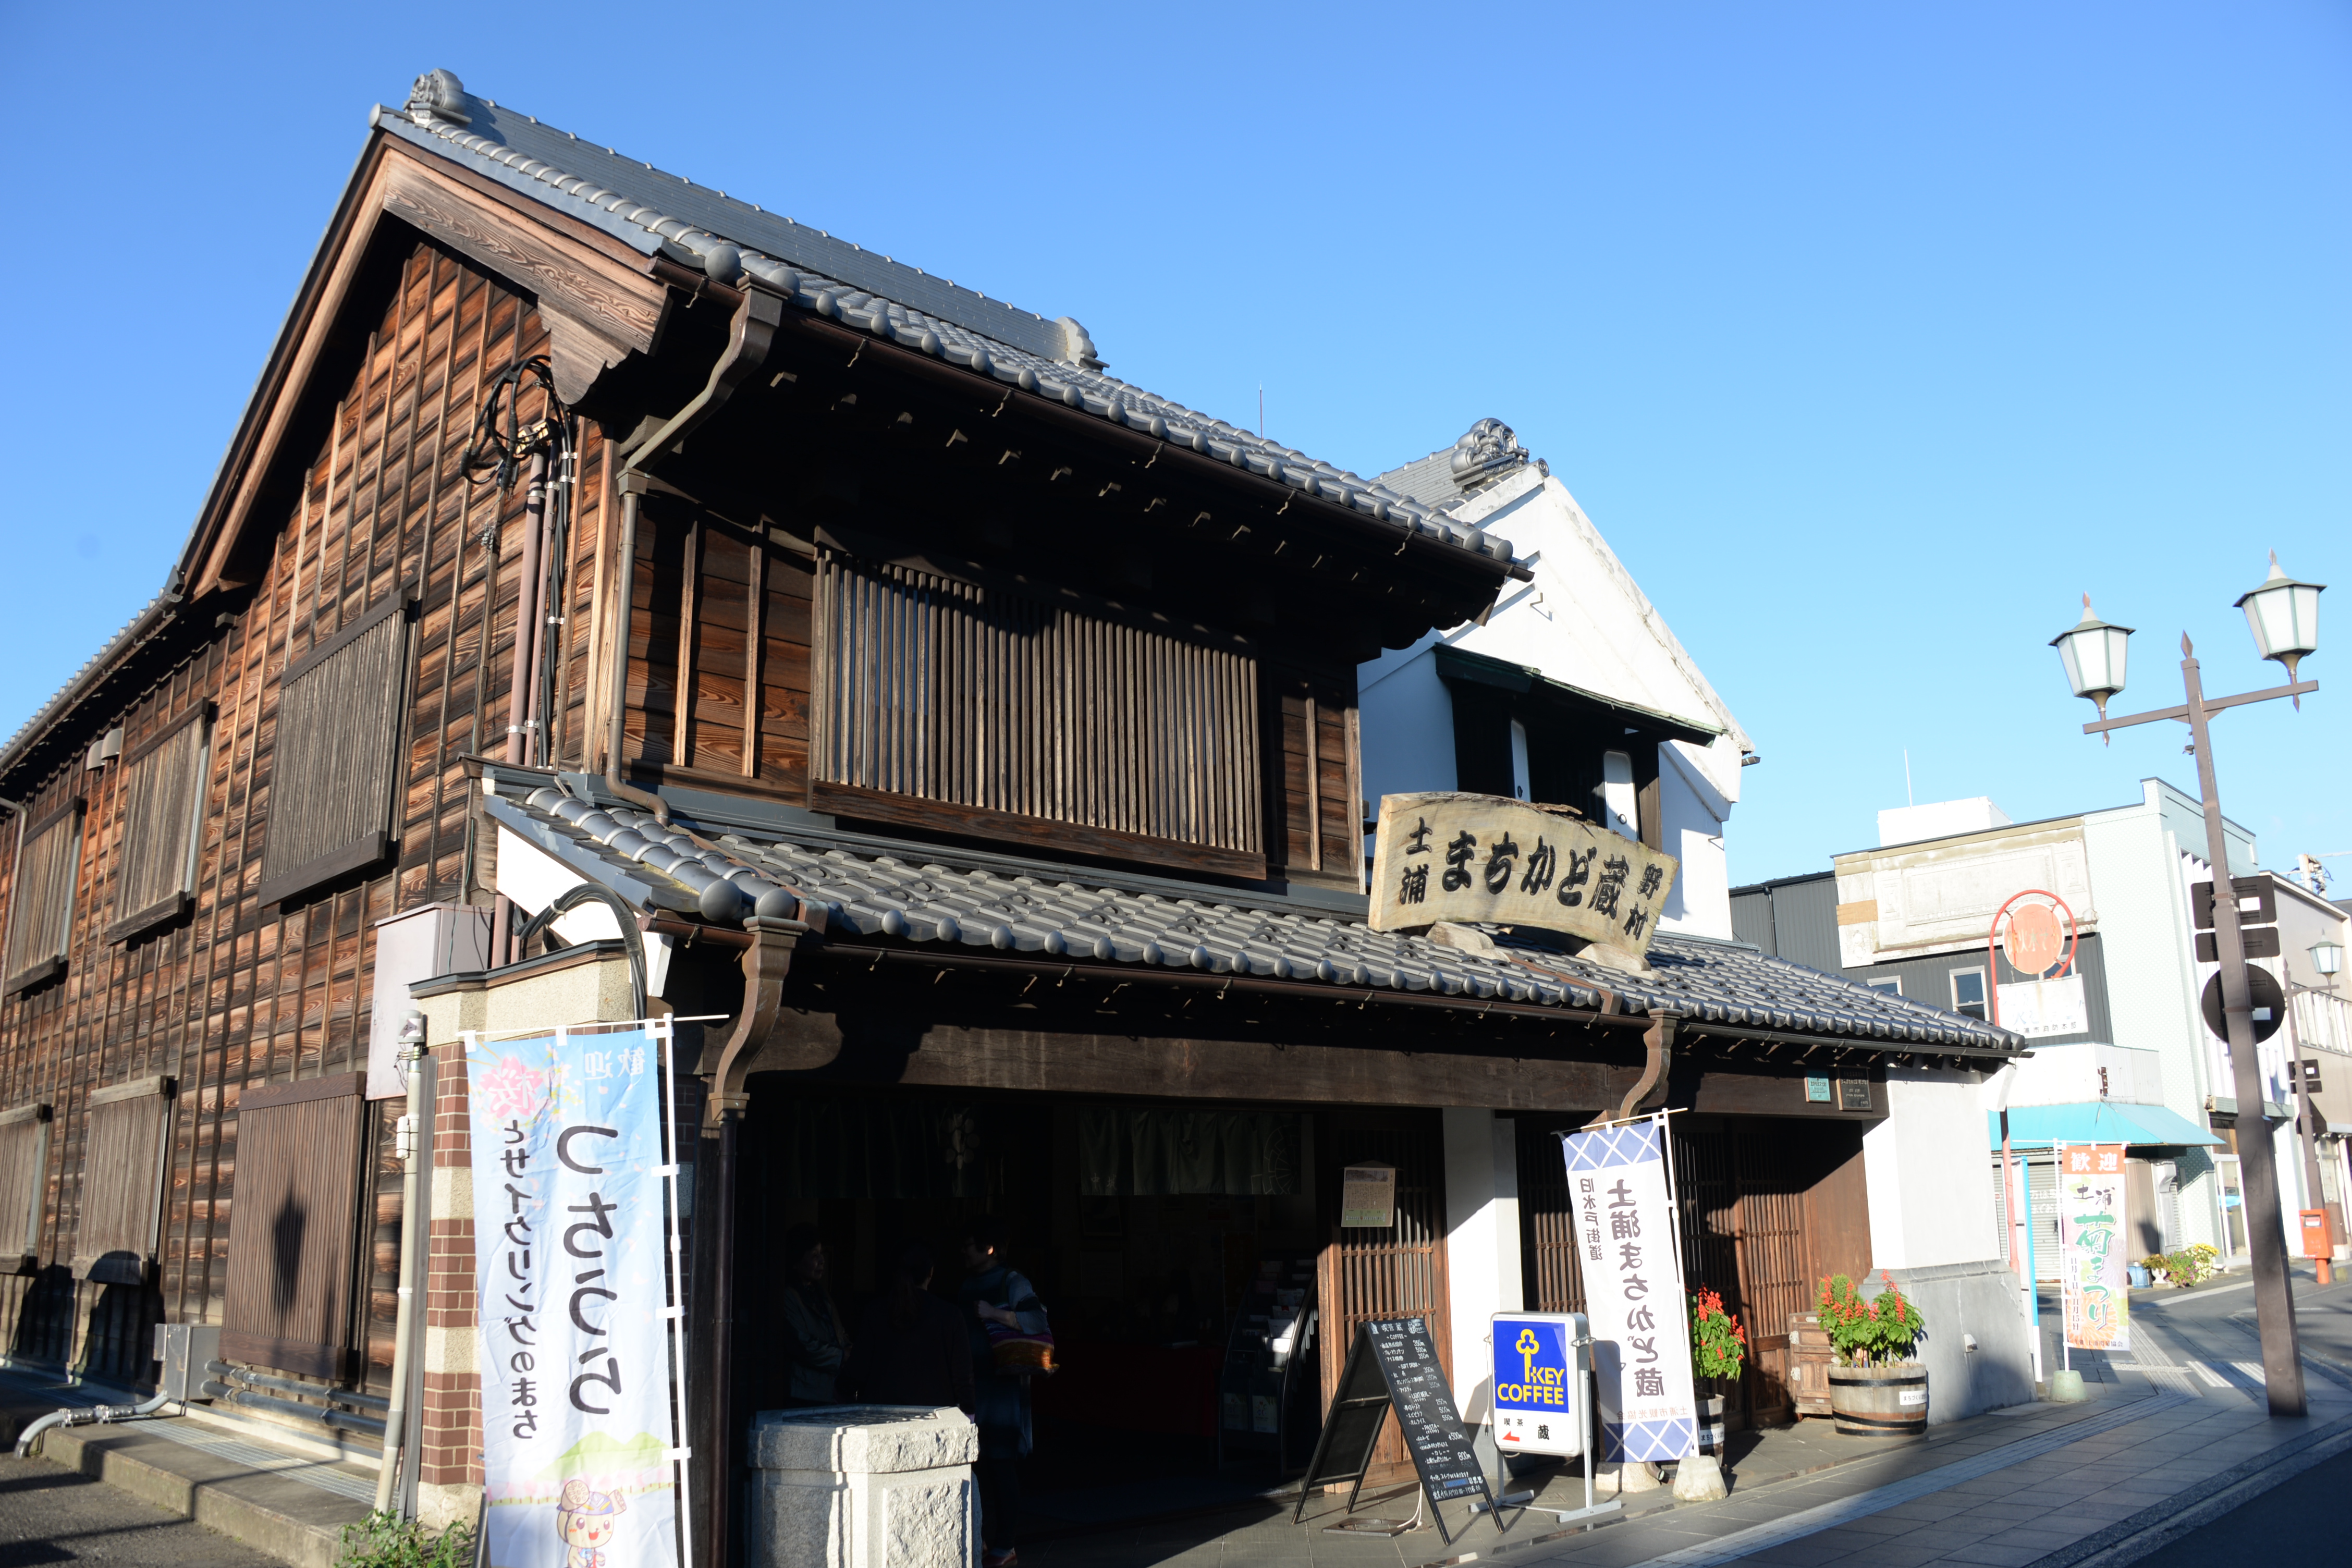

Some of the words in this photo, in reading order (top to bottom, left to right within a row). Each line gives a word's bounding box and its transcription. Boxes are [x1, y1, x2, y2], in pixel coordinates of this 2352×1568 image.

[1399, 816, 1432, 904] 土浦
[1442, 830, 1630, 920] まちかど蔵
[1623, 862, 1663, 940] 野村
[2071, 1152, 2118, 1172] 歓迎
[2073, 1184, 2115, 1208] 土浦
[2073, 1211, 2116, 1330] 菊まつり
[1528, 1367, 1564, 1385] KEY
[1497, 1382, 1564, 1405] COFFEE
